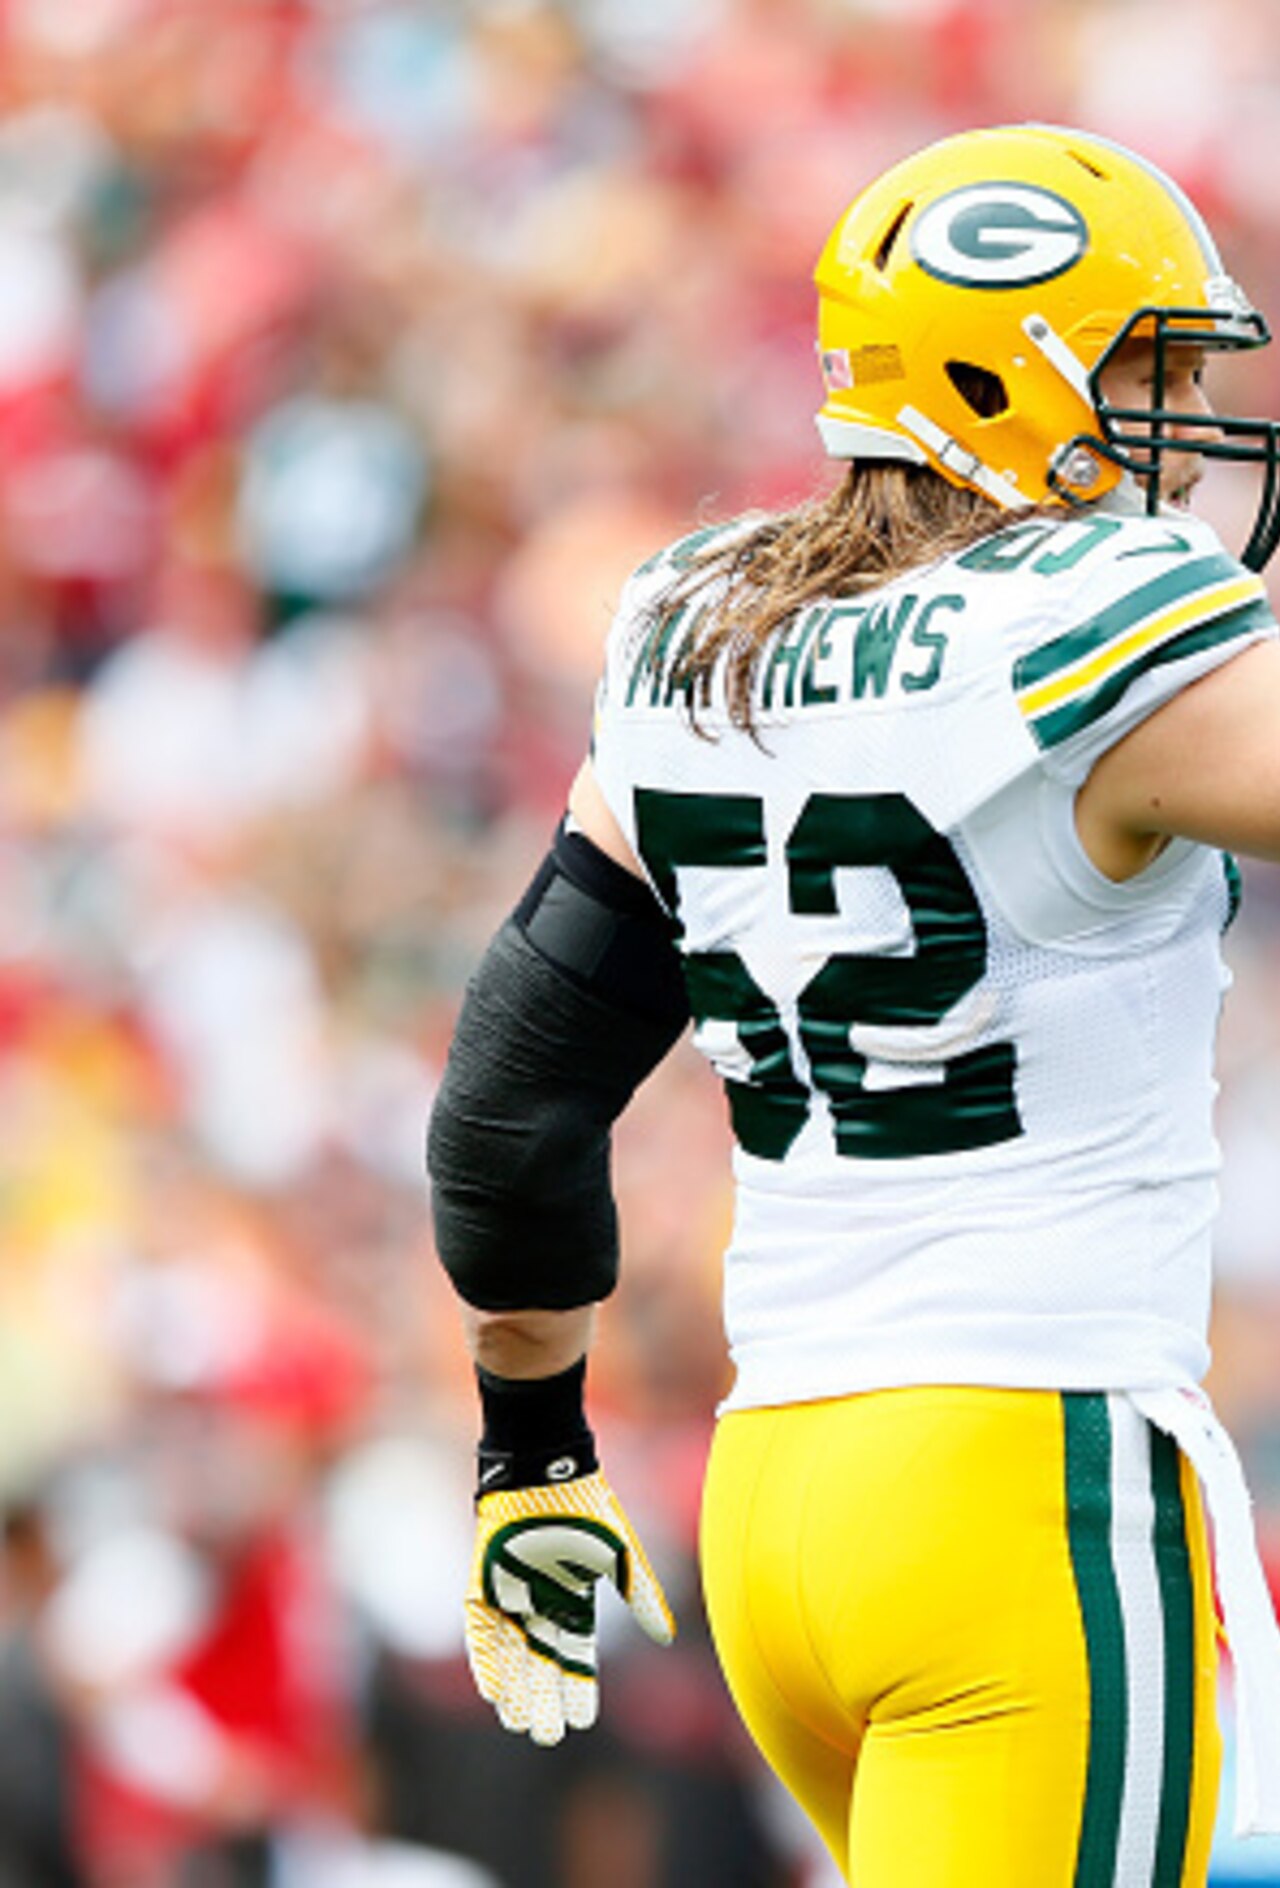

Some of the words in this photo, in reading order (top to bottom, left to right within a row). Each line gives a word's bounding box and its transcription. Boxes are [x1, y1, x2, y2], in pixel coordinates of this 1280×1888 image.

[911, 183, 1088, 286] G
[624, 593, 965, 707] MAHEWS
[633, 786, 1024, 1162] 52
